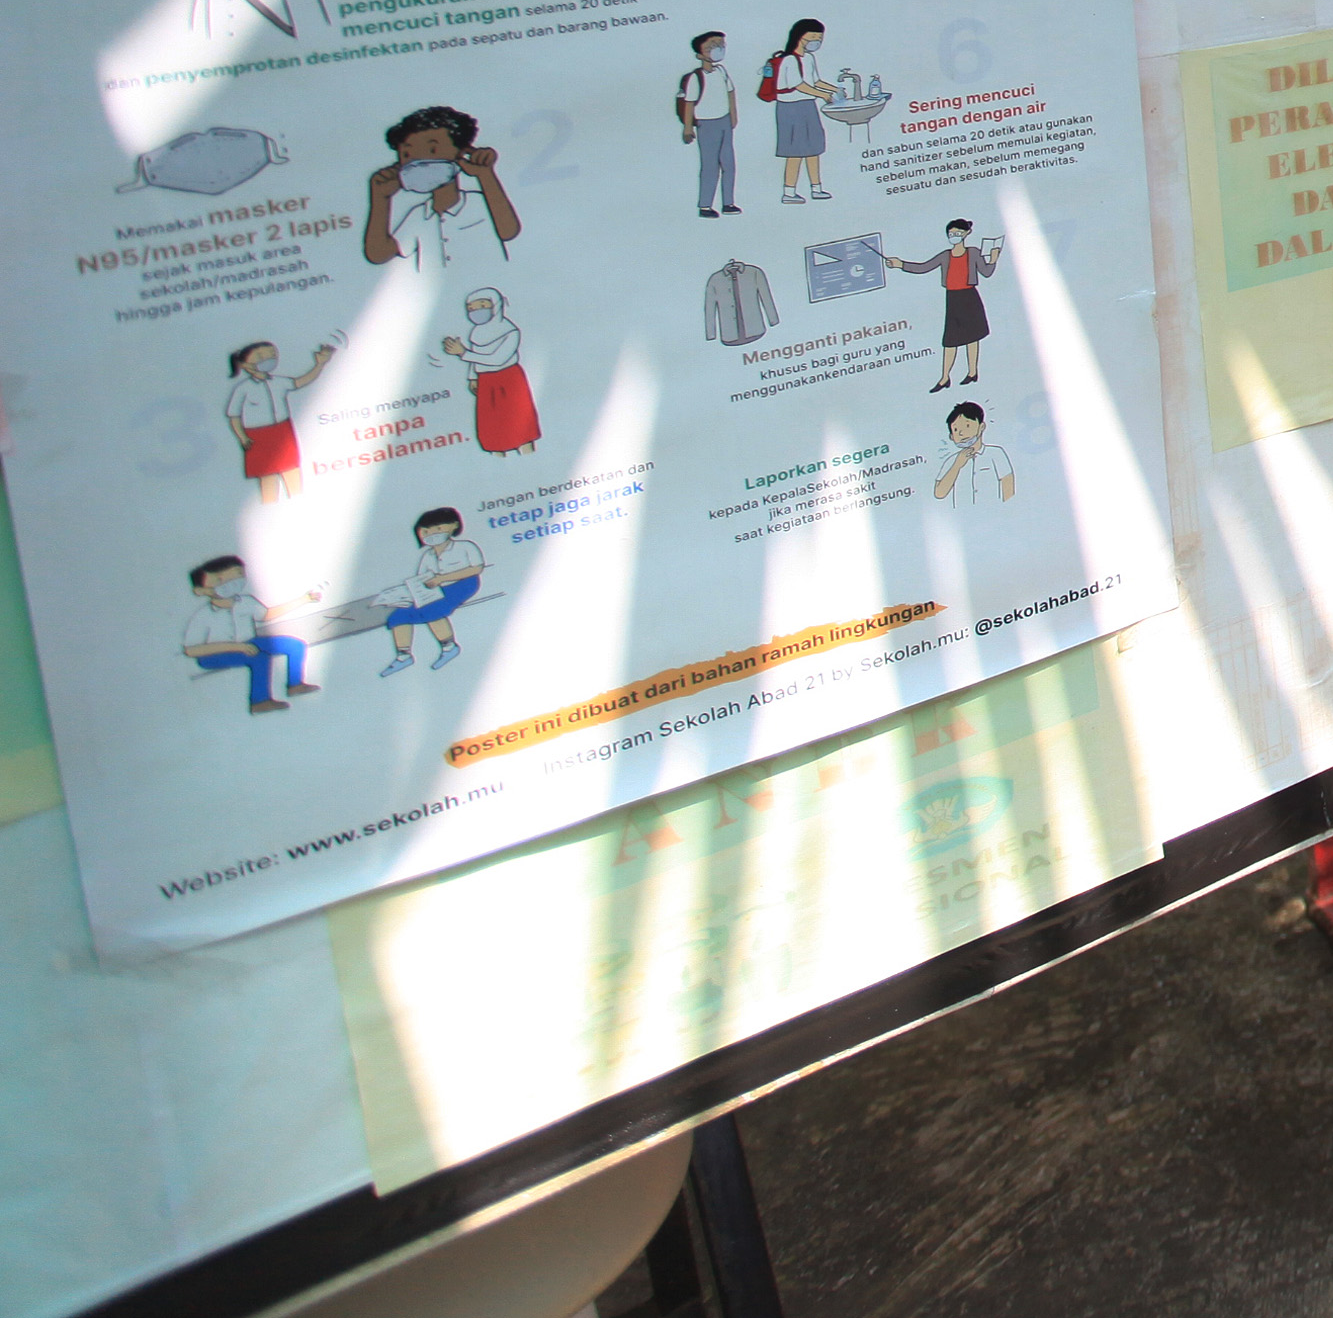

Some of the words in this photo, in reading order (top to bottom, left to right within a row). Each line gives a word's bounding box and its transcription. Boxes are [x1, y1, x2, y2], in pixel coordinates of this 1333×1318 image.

[341, 12, 440, 38] mencuci
[445, 4, 520, 29] tangan
[524, 1, 576, 17] selama
[144, 54, 301, 89] penyemprotan
[306, 39, 423, 66] desinfektan
[428, 35, 467, 53] pada
[471, 28, 523, 48] sepatu
[526, 22, 554, 38] dan
[557, 17, 608, 36] barang
[611, 10, 669, 29] bawaan.
[900, 115, 959, 135] tangan
[962, 105, 1023, 126] dengan
[1026, 100, 1046, 115] air
[908, 95, 963, 115] Sering
[966, 82, 1035, 105] mencuci
[860, 159, 890, 173] hand
[893, 150, 943, 168] sanitizer
[946, 143, 994, 159] sebelum
[997, 134, 1044, 151] memulai
[1046, 127, 1097, 145] kegiatan,
[861, 147, 884, 160] dan
[887, 141, 924, 155] sabun
[926, 134, 967, 149] selama
[970, 130, 985, 142] 20
[987, 125, 1016, 139] detik
[1019, 121, 1043, 134] atau
[1045, 114, 1093, 132] gunakan
[876, 167, 926, 184] sebelum
[929, 161, 971, 177] makan,
[973, 152, 1020, 168] sebelum
[1023, 141, 1085, 160] memegang
[886, 180, 933, 196] sesuatu
[935, 174, 957, 187] dan
[960, 166, 1008, 182] sesudah
[1010, 155, 1078, 175] beraktivitas.
[207, 195, 311, 225] masker
[75, 229, 259, 275] N95/masker
[265, 223, 283, 242] 2
[289, 213, 354, 238] lapis
[742, 332, 838, 366] Mengganti
[841, 317, 913, 346] pakaian,
[760, 361, 808, 381] khusus
[811, 353, 840, 371] bagi
[842, 347, 872, 365] guru
[874, 339, 906, 358] yang
[894, 346, 936, 365] umum.
[450, 725, 529, 762] Poster
[533, 713, 562, 734] ini
[567, 690, 640, 724] dibuat
[644, 674, 687, 699] dari
[690, 655, 757, 686] bahan
[761, 633, 825, 665] ramah
[829, 599, 936, 642] lingkungan
[159, 852, 281, 901] Website:
[286, 781, 503, 860] www.sekolah.mu
[659, 701, 741, 737] Sekolah
[747, 682, 798, 710] Abad
